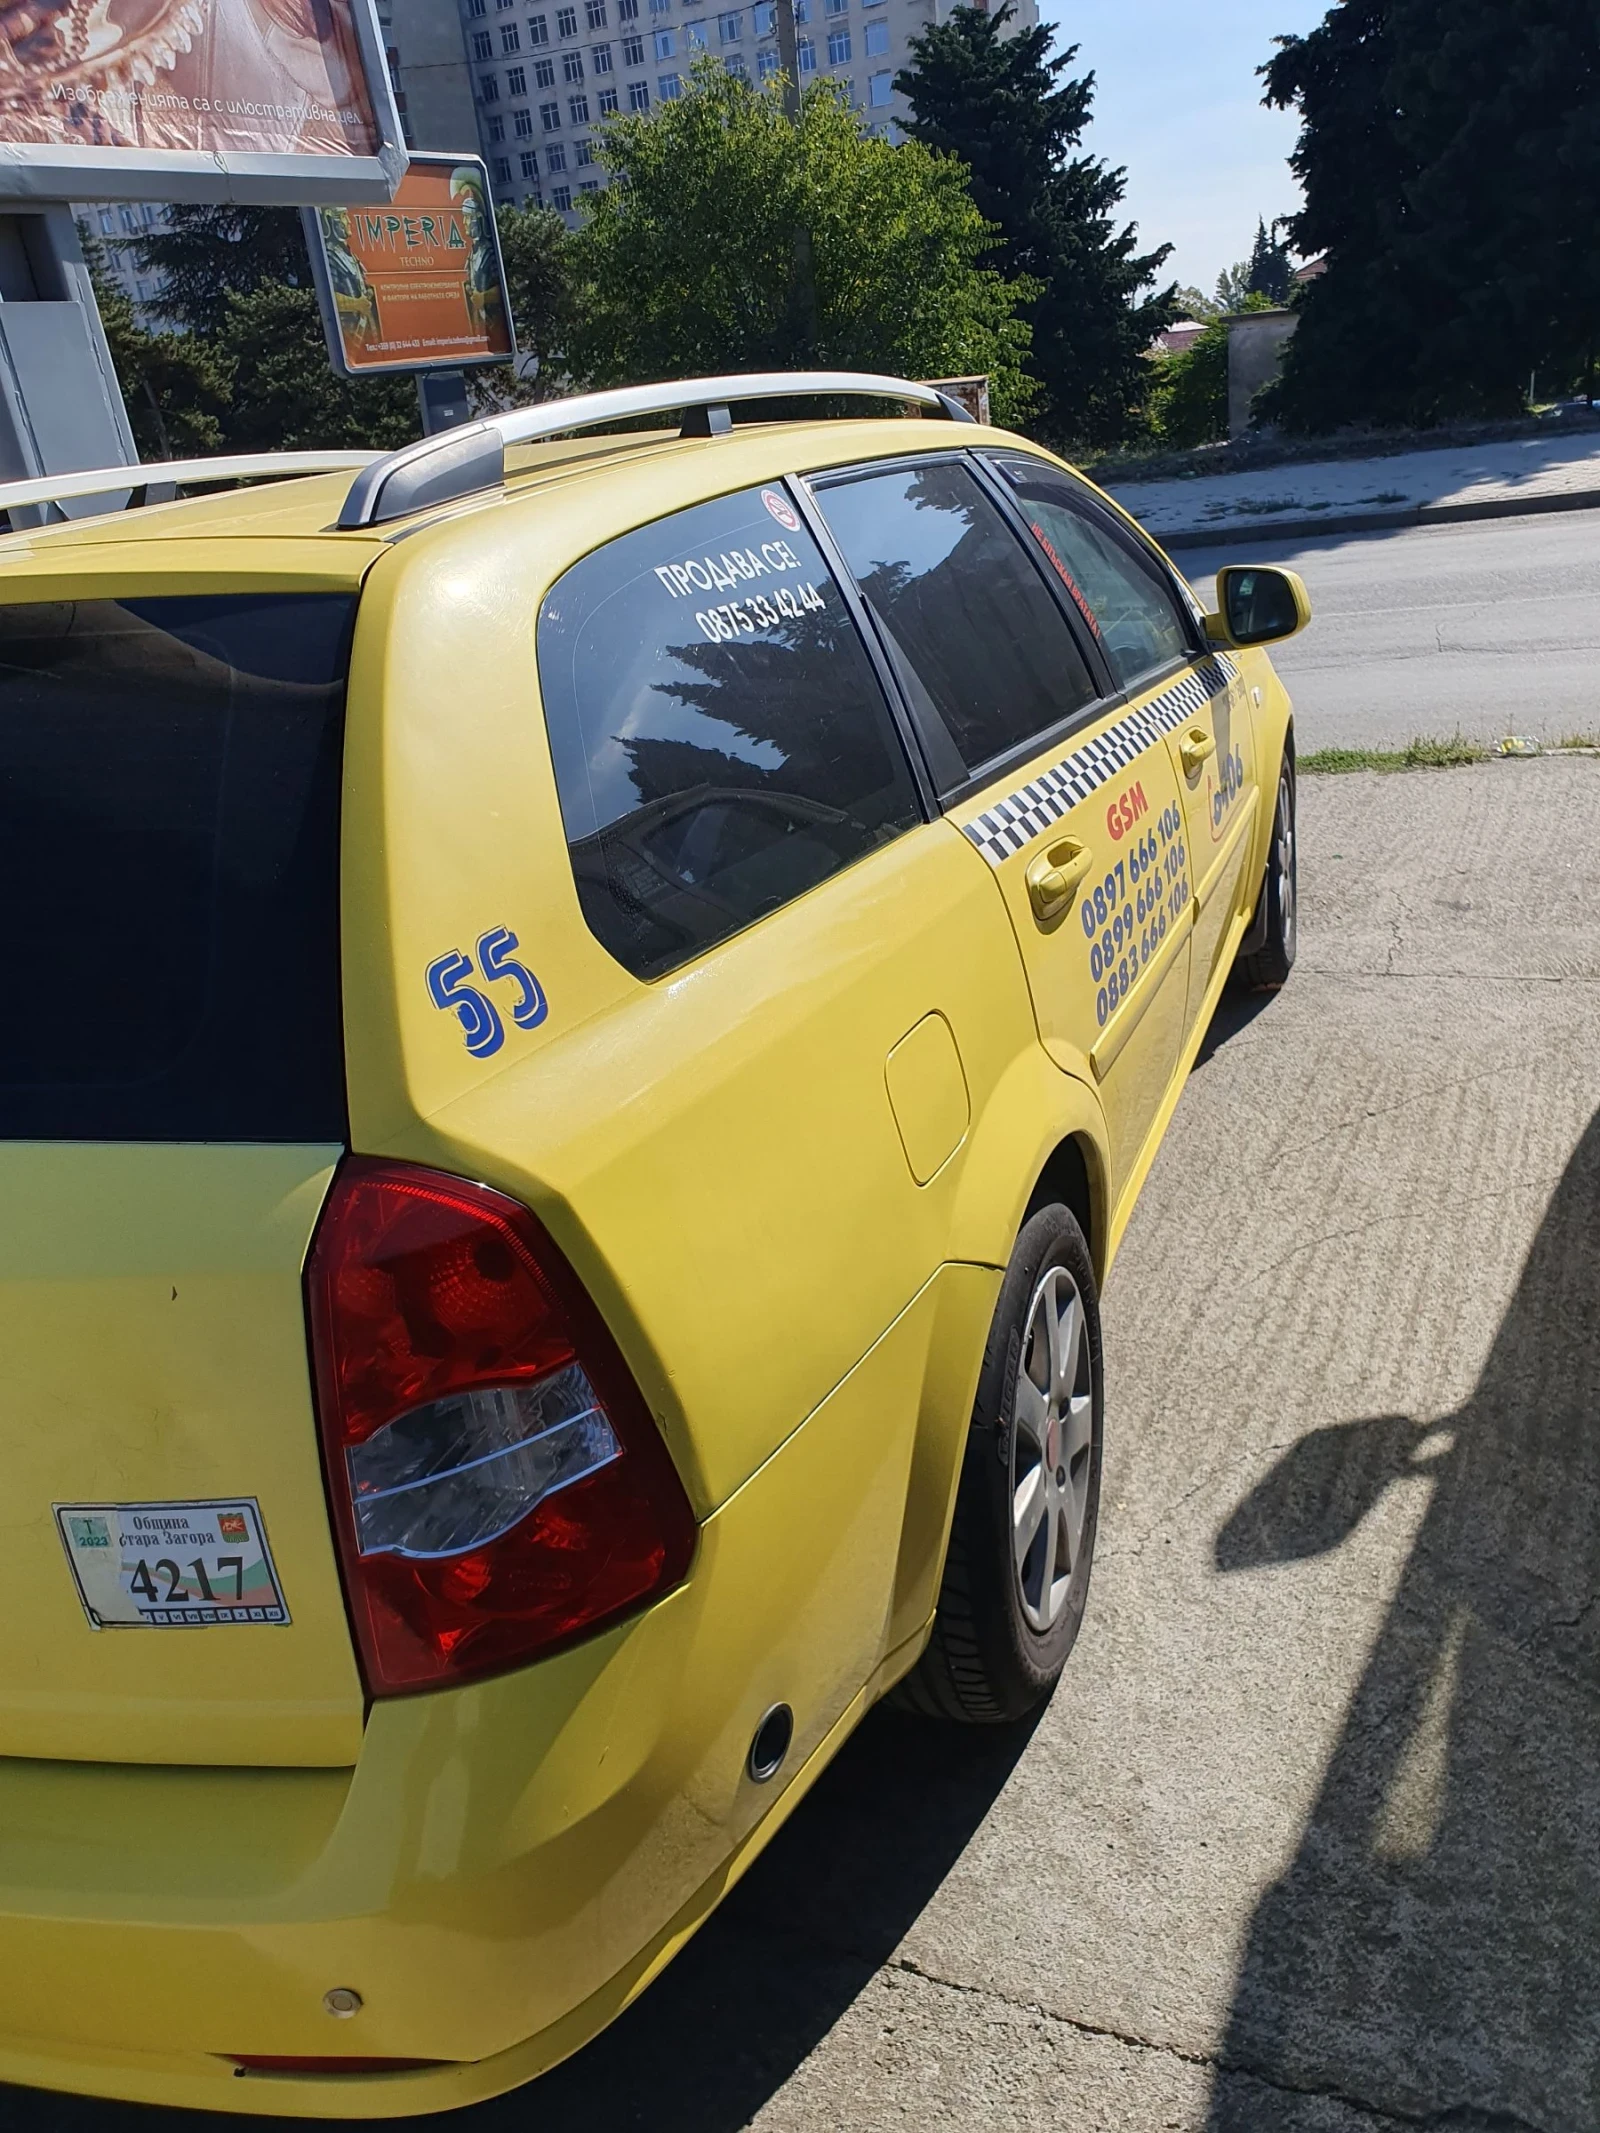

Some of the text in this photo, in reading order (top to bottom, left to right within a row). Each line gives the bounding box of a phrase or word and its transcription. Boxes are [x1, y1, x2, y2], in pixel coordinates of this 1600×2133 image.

[51, 83, 190, 111] Изображенията
[192, 97, 212, 112] са
[213, 101, 224, 114] с
[227, 98, 337, 123] илюстративна
[353, 214, 467, 253] IMPERIA
[399, 256, 435, 267] TECHNO
[653, 540, 802, 599] ПРОДАВА СЕ!
[695, 581, 827, 644] 0875 33 42 44
[1106, 780, 1149, 841] GSM
[1081, 799, 1181, 940] 0897 666 106
[1090, 835, 1186, 983] 0899 666 106
[1096, 871, 1189, 1028] 0883 666 106
[425, 924, 549, 1059] 55
[79, 1536, 109, 1547] 2023
[132, 1515, 191, 1532] Община
[162, 1530, 216, 1547] Загора
[130, 1556, 244, 1603] 4217
